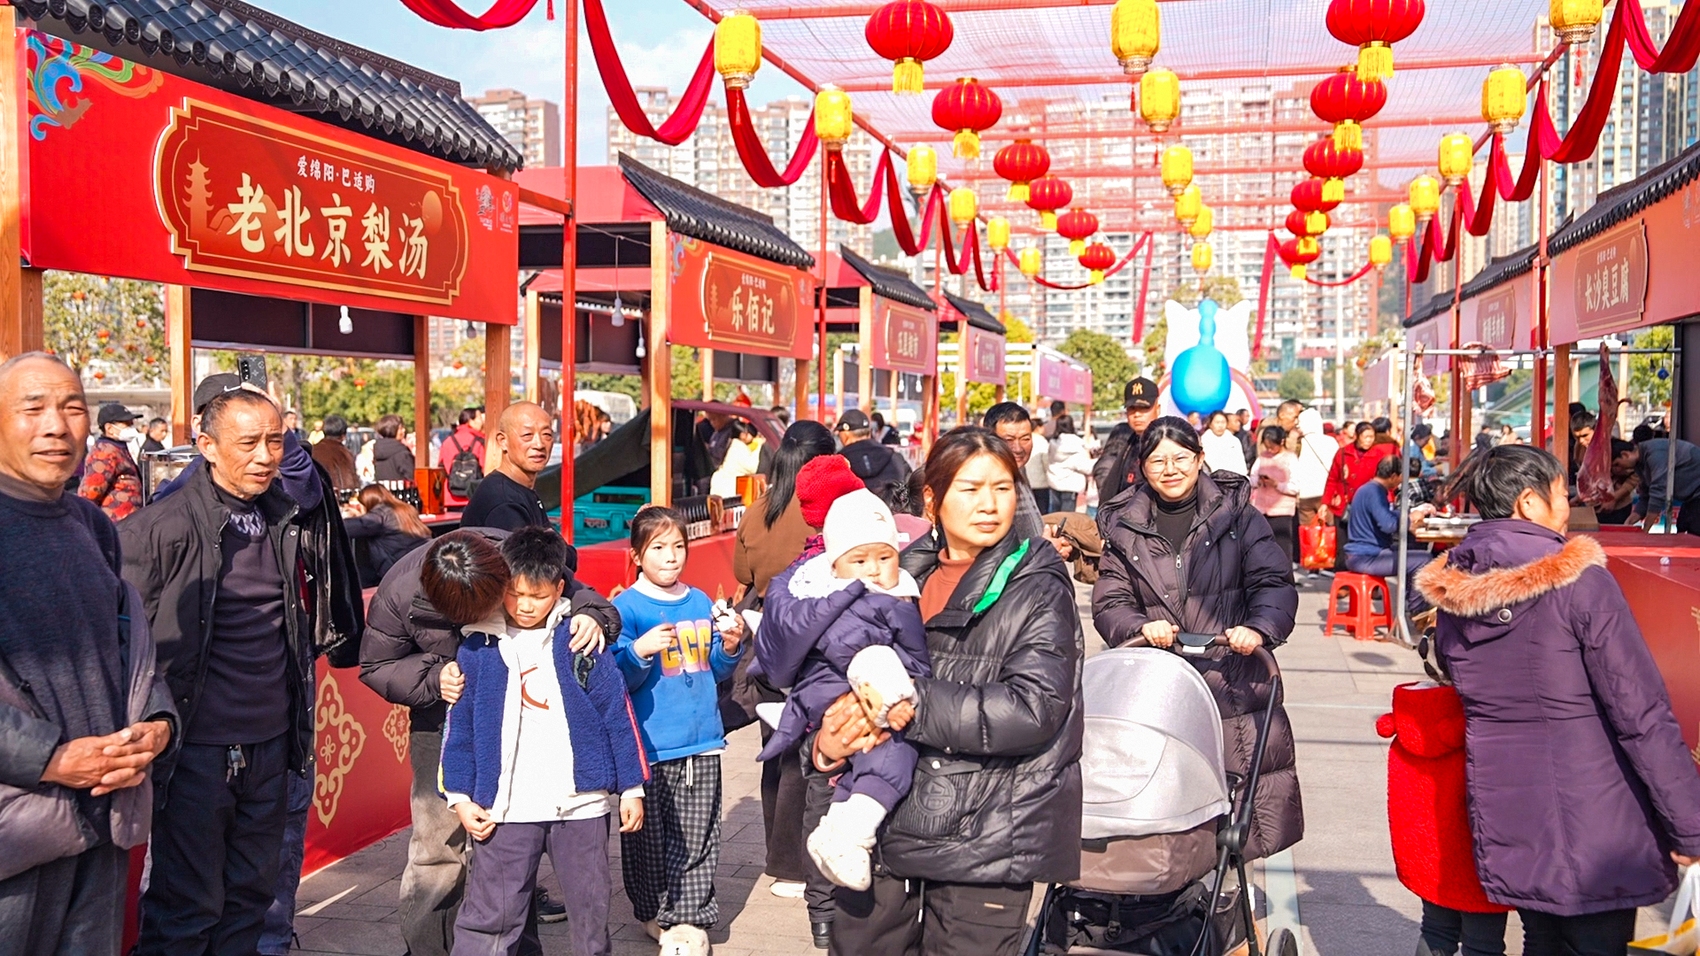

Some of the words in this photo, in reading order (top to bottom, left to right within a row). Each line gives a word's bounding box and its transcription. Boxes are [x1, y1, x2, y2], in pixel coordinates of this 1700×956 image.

[297, 155, 375, 194] 爱绵阳·巴适购
[226, 172, 429, 279] 老北京梨汤
[731, 285, 775, 335] 乐佰记
[1585, 256, 1629, 313] 长沙臭豆腐
